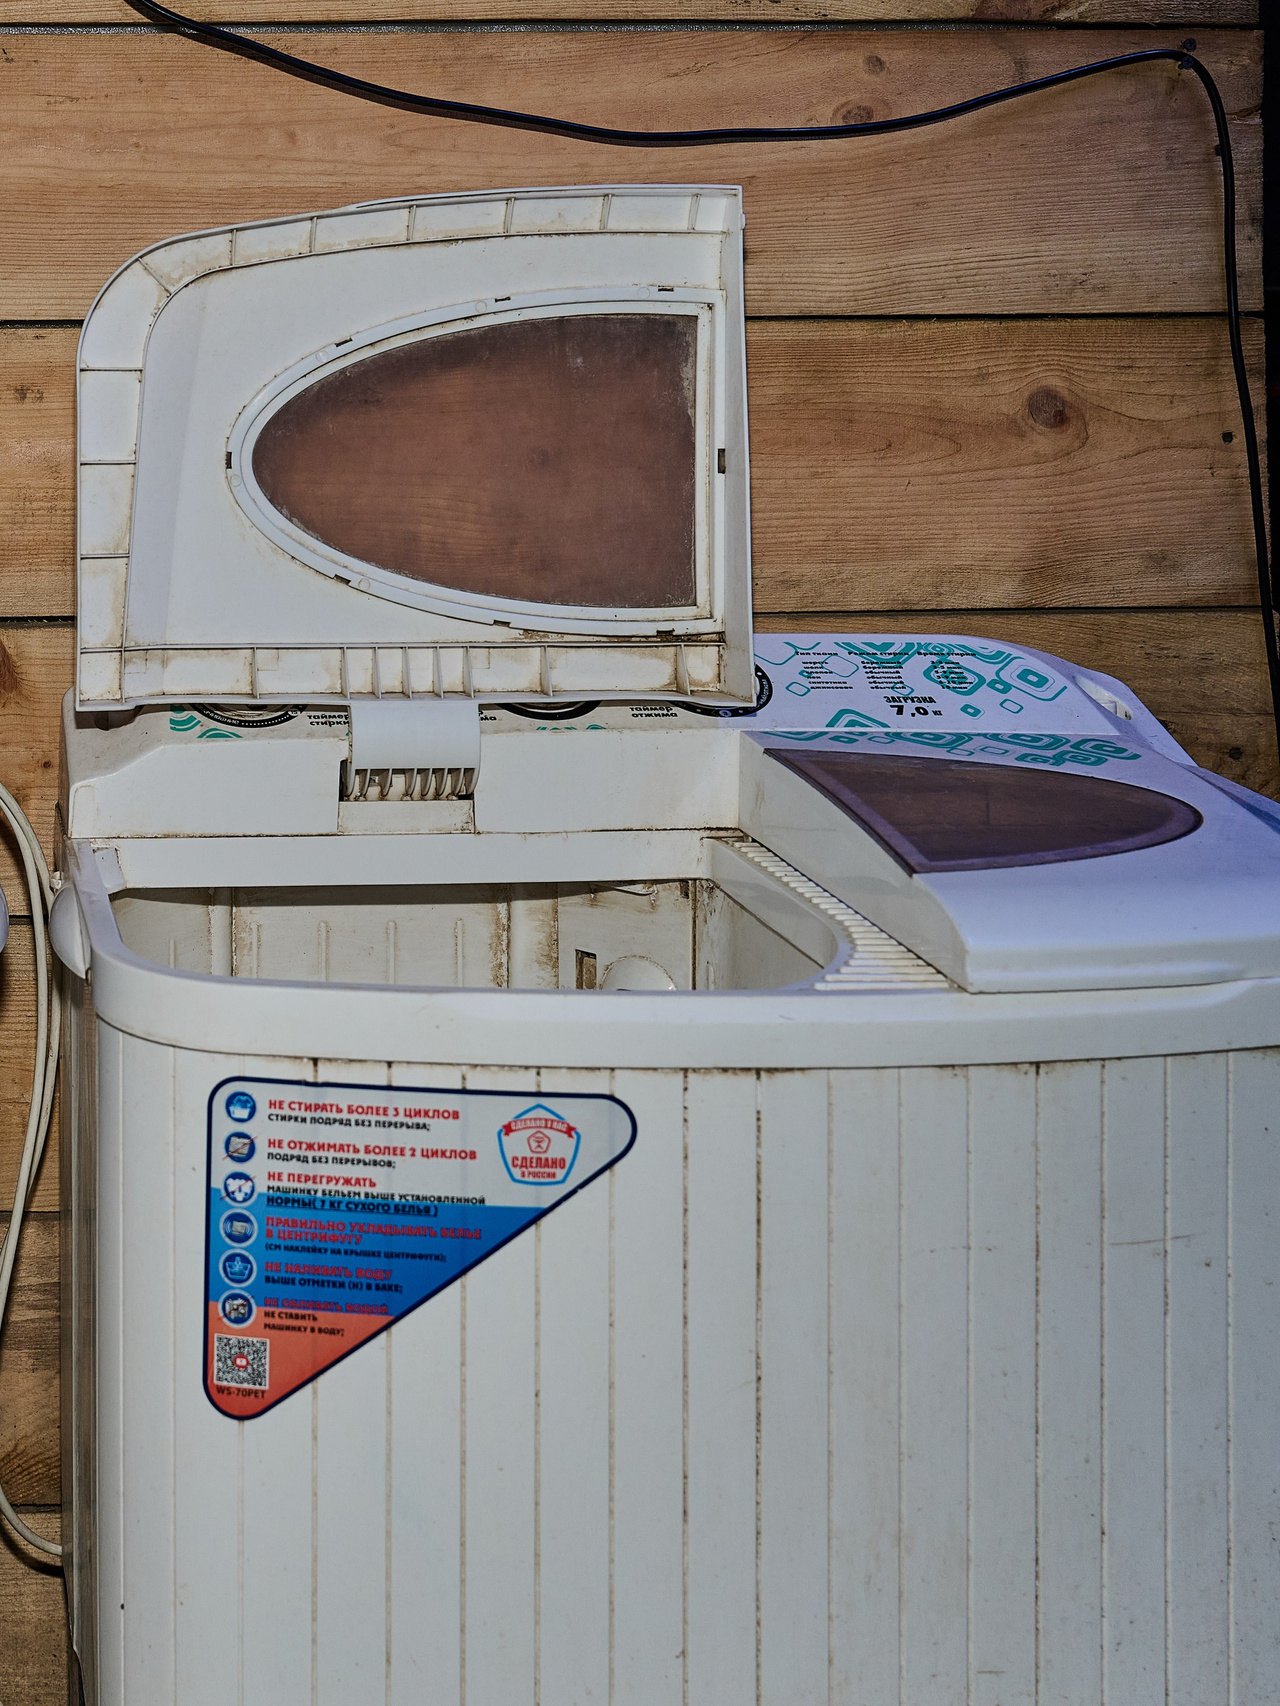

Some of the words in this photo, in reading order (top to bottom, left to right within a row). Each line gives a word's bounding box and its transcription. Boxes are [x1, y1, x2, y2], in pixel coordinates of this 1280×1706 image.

[629, 705, 673, 713] таймер
[268, 1099, 285, 1110] НЕ
[288, 1101, 343, 1114] СТИРАТЬ
[347, 1104, 389, 1117] БОЛЕЕ
[392, 1106, 400, 1117] 3
[404, 1107, 460, 1120] ЦИКЛОВ
[268, 1113, 307, 1124] СТИРКИ
[310, 1116, 352, 1127] ПОДРЯД
[354, 1118, 372, 1127] БЕЗ
[268, 1139, 284, 1149] НЕ
[287, 1140, 360, 1154] ОТЖИМАТЬ
[364, 1144, 406, 1157] БОЛЕЕ
[409, 1147, 416, 1157] 2
[421, 1147, 477, 1160] ЦИКЛОВ
[267, 1152, 309, 1164] ПОДРЯД
[311, 1156, 329, 1164] БЕЗ
[512, 1155, 566, 1170] СДЕЛАНО
[267, 1171, 284, 1182] НЕ
[287, 1172, 377, 1188] ПЕРЕГРУЖАТЬ
[267, 1185, 319, 1195] МАШИНКУ
[321, 1188, 361, 1198] БЕЛЬЕМ
[364, 1191, 395, 1200] ВЫШЕ
[398, 1193, 486, 1205] УСТАНОВЛЕННОЙ
[320, 1200, 326, 1209] 7
[329, 1200, 341, 1209] КГ
[345, 1201, 391, 1213] СУХОГО
[393, 1203, 431, 1214] БЕЛЬЯ
[265, 1216, 346, 1231] ПРАВИЛЬНО
[350, 1222, 437, 1237] УКЛАДЫВАТЬ
[441, 1227, 481, 1239] БЕЛЬЕ
[265, 1229, 274, 1239] В
[277, 1229, 363, 1245] ЦЕНТРИФУГУ
[265, 1261, 281, 1272] НЕ
[285, 1262, 352, 1278] НАЛИВАТЬ
[355, 1268, 392, 1280] ВОДУ
[264, 1275, 296, 1286] ВЫШЕ
[298, 1278, 346, 1289] ОТМЕТКИ
[264, 1297, 278, 1307] НЕ
[281, 1298, 343, 1312] ОБЛИВАТЬ
[345, 1302, 388, 1314] ВОДОЙ
[264, 1310, 275, 1318] НЕ
[277, 1311, 318, 1321] СТАВИТЬ
[263, 1323, 307, 1333] МАШИНКУ
